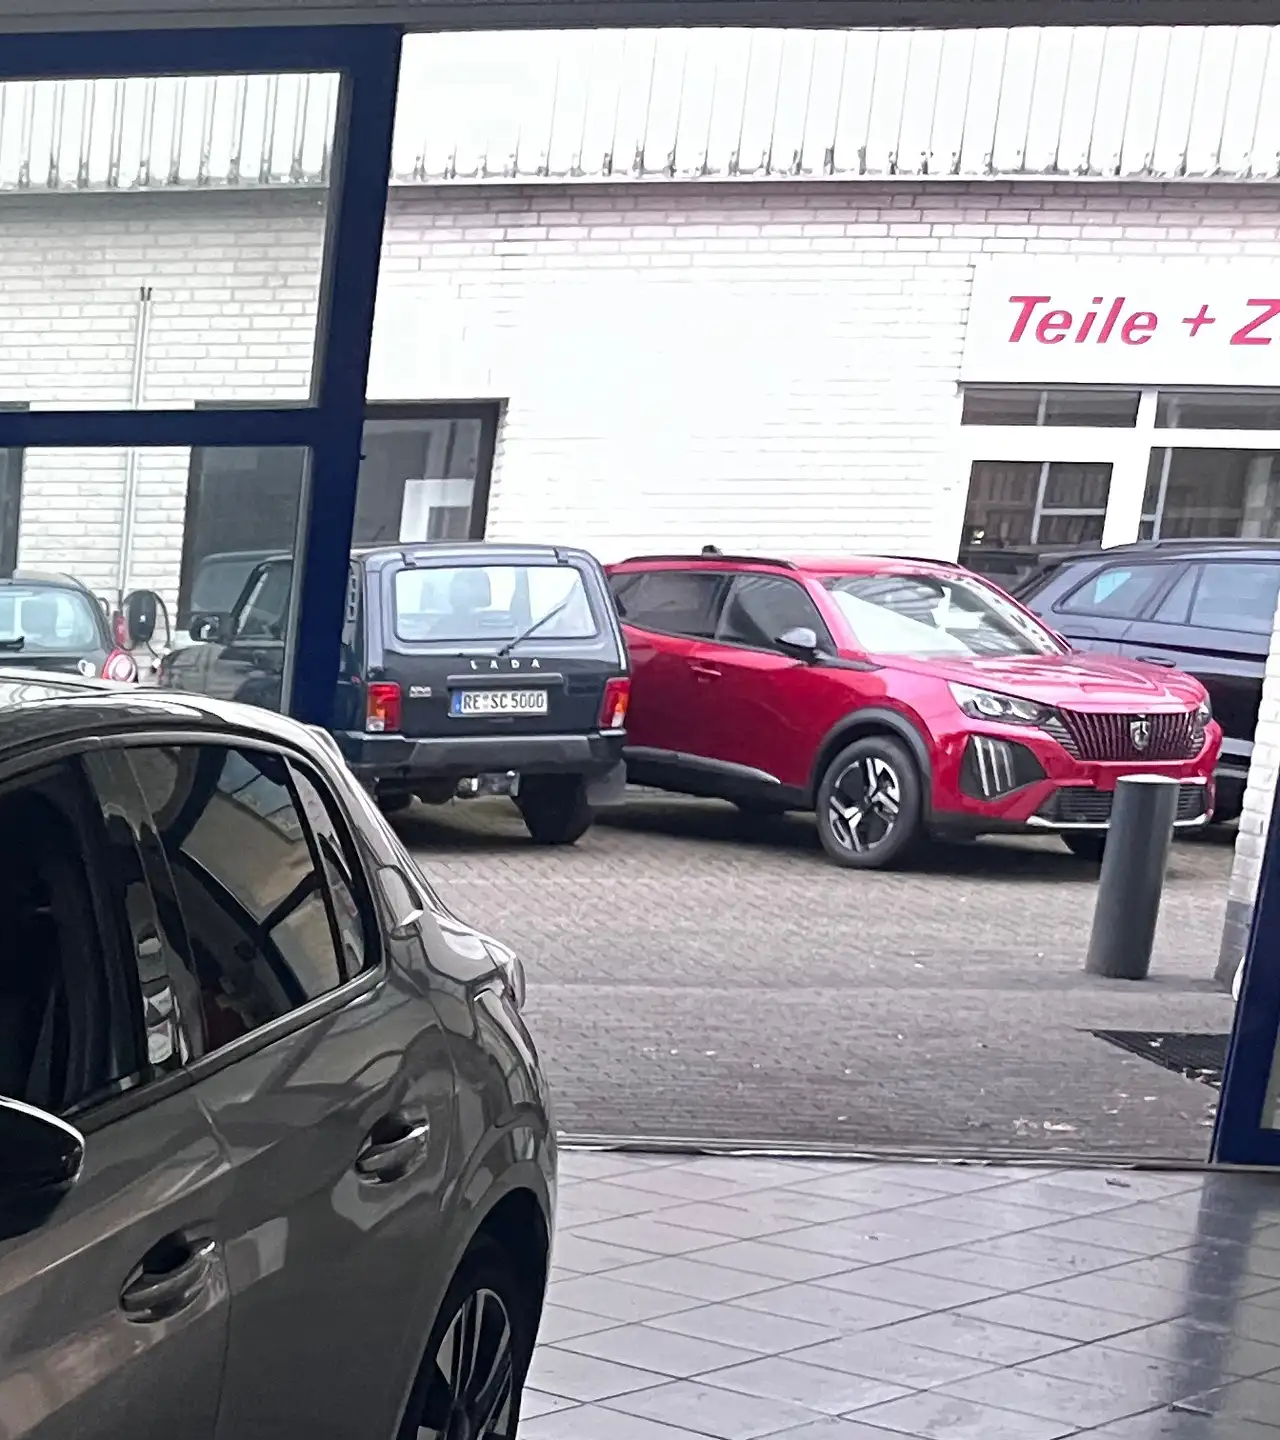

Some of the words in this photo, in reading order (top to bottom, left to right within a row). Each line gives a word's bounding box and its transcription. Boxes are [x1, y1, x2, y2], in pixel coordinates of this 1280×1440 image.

[1008, 295, 1158, 345] Teile
[1182, 304, 1216, 337] +
[1229, 298, 1280, 345] Z
[470, 658, 540, 670] LADA
[463, 693, 480, 710] RE
[490, 693, 508, 709] SC
[510, 692, 544, 709] 5000
